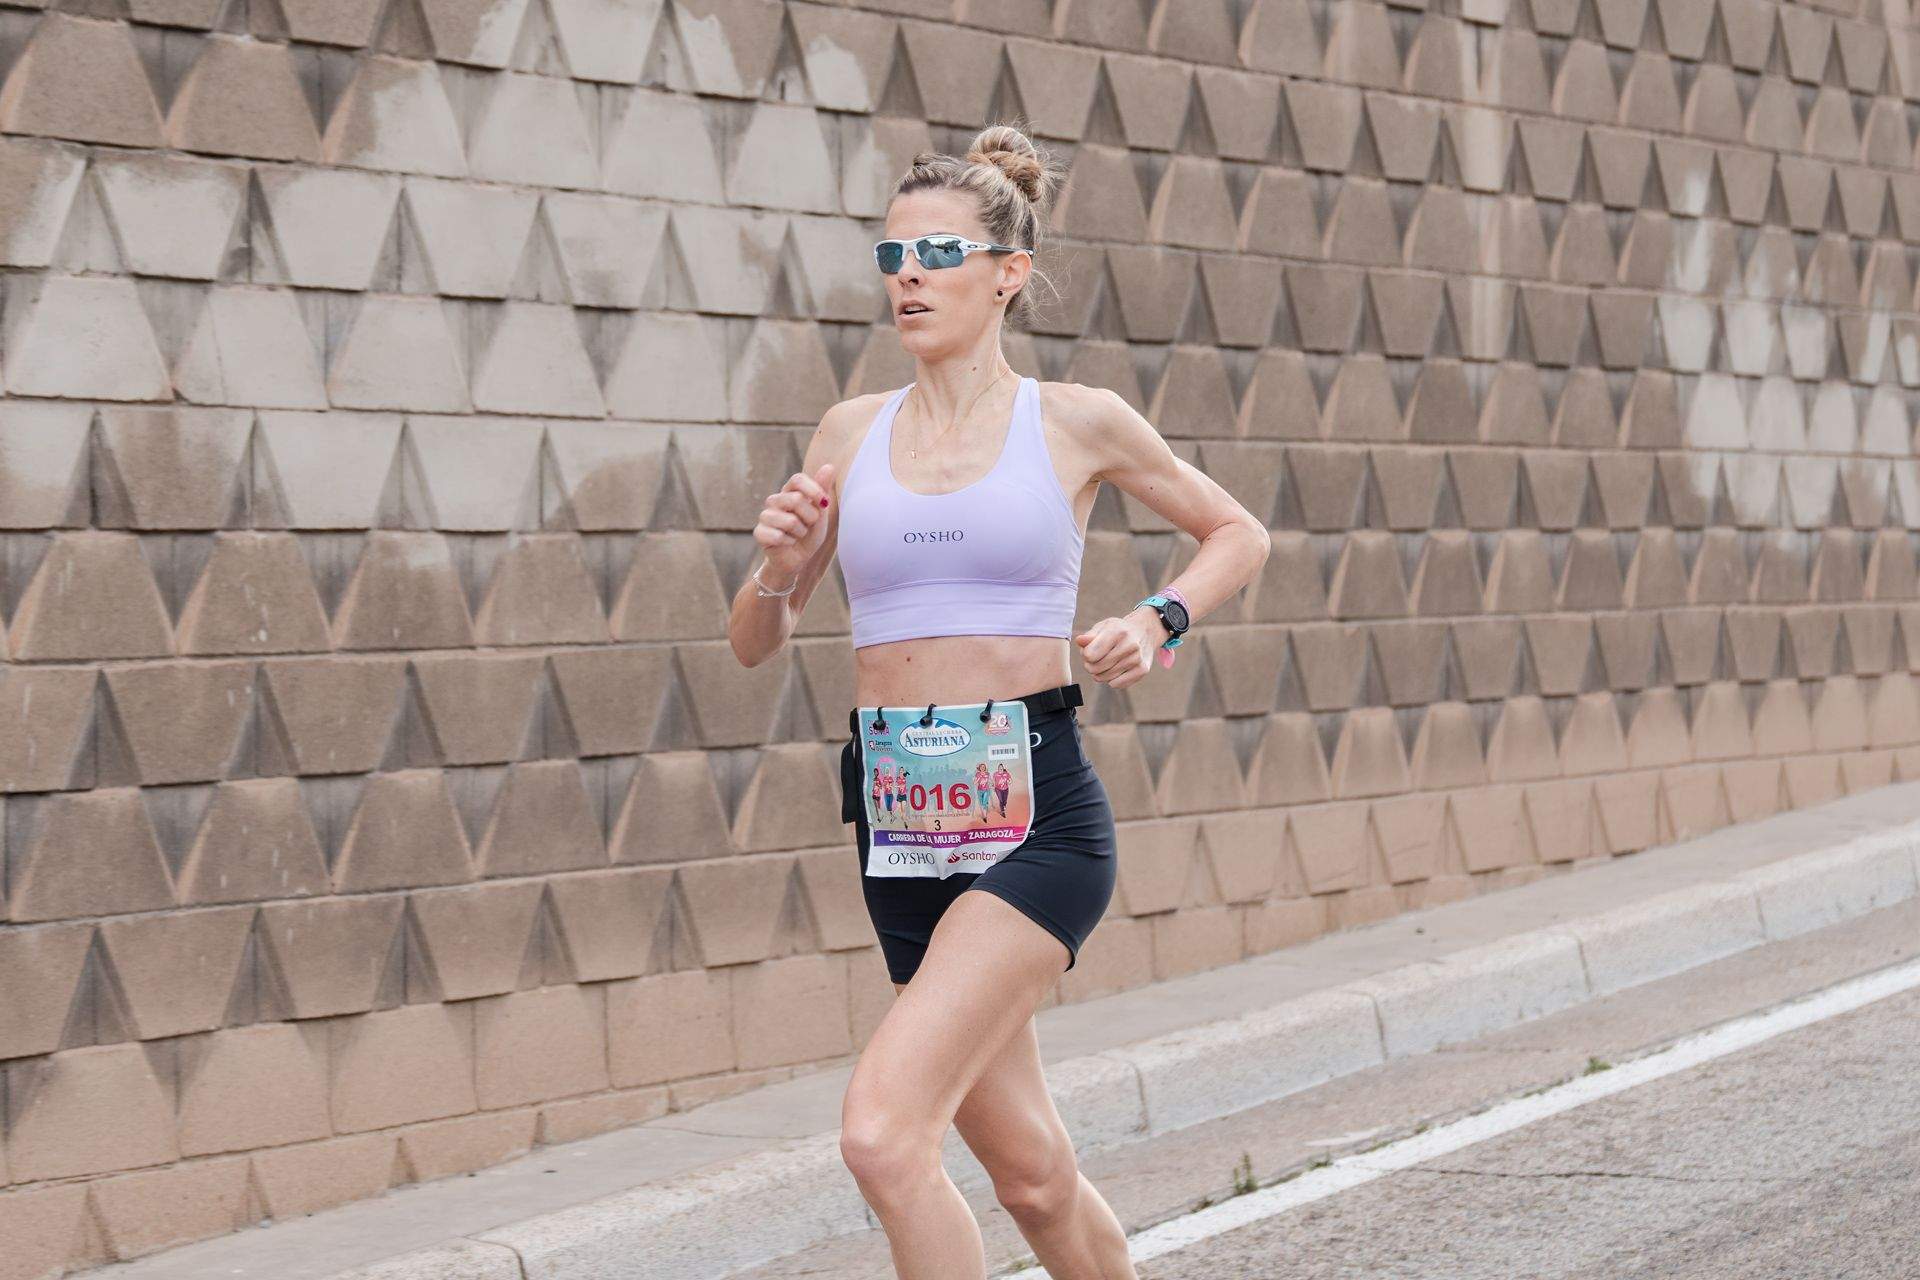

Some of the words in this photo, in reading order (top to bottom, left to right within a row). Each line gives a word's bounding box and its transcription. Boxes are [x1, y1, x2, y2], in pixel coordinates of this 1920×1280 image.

[903, 529, 964, 544] OYSHO
[905, 732, 966, 748] ASTURIANA
[909, 783, 972, 811] 016
[934, 819, 942, 831] 3
[888, 833, 916, 843] CARRERA
[916, 834, 926, 843] DE
[933, 835, 962, 844] MUJER
[968, 829, 1014, 840] ZARAGOZA
[888, 852, 936, 865] OYSHO
